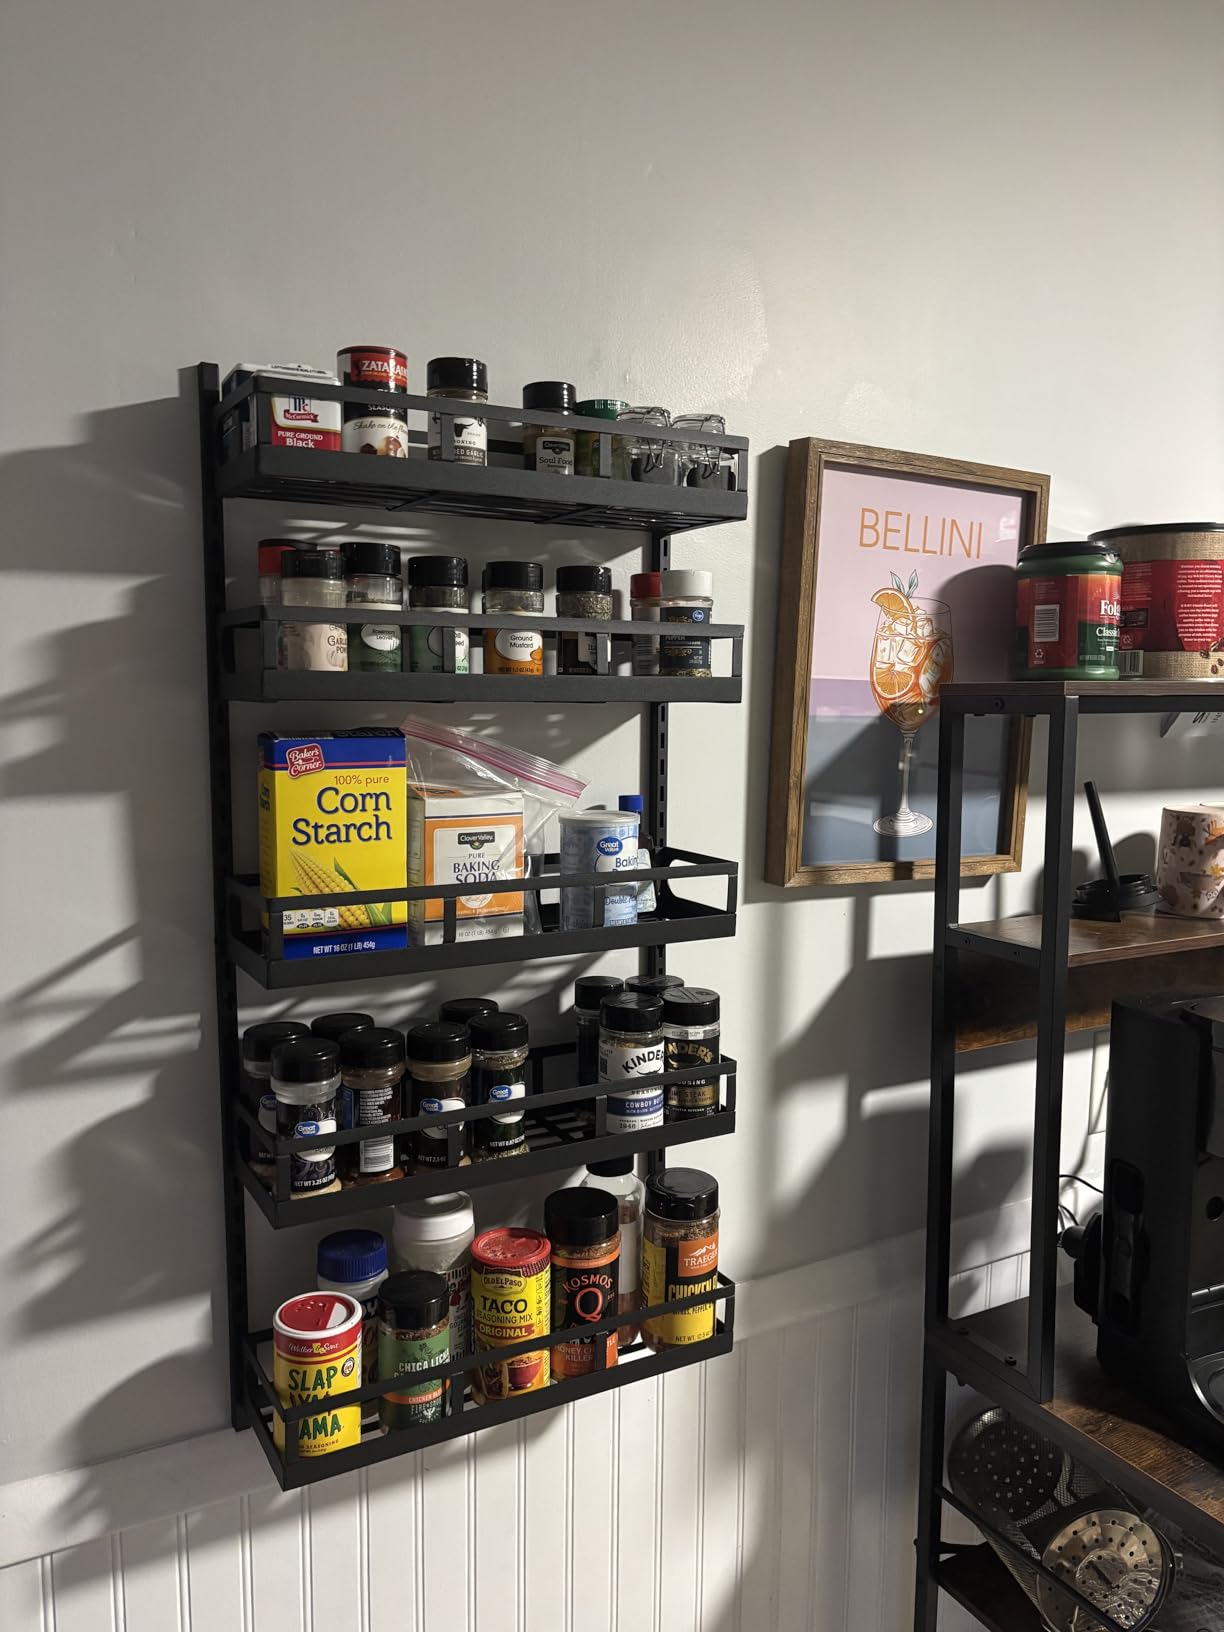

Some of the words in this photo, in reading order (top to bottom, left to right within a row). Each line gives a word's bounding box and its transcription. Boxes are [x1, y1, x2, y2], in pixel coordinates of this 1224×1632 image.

[285, 412, 315, 420] McCormick
[295, 432, 323, 440] GROUND
[286, 438, 315, 448] Black
[539, 456, 556, 464] Soul
[859, 507, 983, 560] BELLINI
[510, 634, 533, 642] Ground
[288, 748, 320, 763] Baker's
[290, 761, 322, 776] Corner
[334, 775, 362, 785] 100%
[365, 777, 390, 787] pure
[317, 787, 392, 815] Corn
[292, 814, 392, 845] Starch
[600, 841, 619, 849] Great
[453, 860, 500, 874] BAKING
[455, 871, 498, 884] SODA
[313, 946, 323, 954] NET
[324, 945, 333, 953] WT
[354, 942, 363, 950] LB)
[363, 941, 376, 950] 454g
[562, 1274, 613, 1293] KOSMOS
[480, 1295, 528, 1315] TACO
[575, 1287, 603, 1323] Q
[520, 1313, 533, 1323] MIX
[479, 1325, 529, 1338] ORIGINAL
[554, 1344, 582, 1355] HONEY
[399, 1361, 429, 1372] CHICA
[288, 1366, 338, 1391] SLAP
[299, 1414, 342, 1441] AMA
